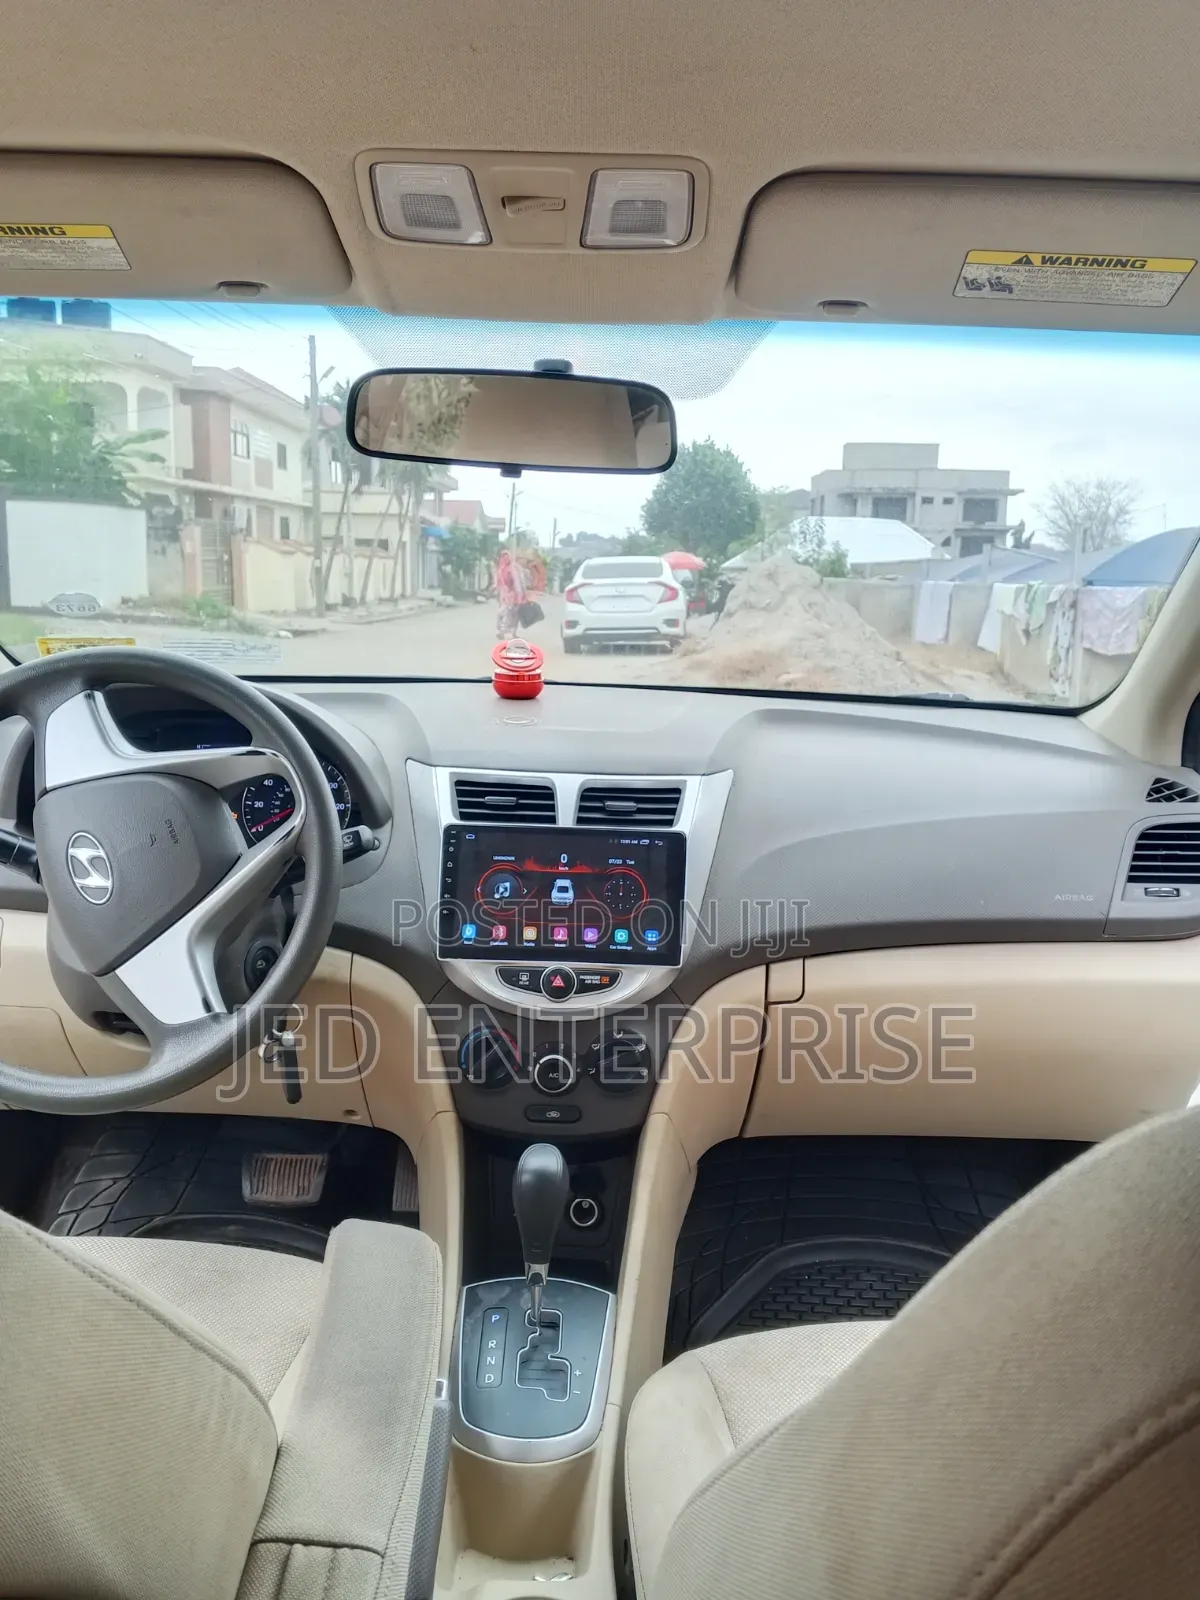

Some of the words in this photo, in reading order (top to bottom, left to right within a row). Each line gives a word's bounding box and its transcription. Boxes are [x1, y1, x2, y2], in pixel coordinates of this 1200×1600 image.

[1040, 255, 1148, 269] WARNING
[164, 818, 180, 845] AIRBAG
[257, 824, 264, 832] 0
[560, 853, 568, 863] 0
[1054, 894, 1095, 902] AIRBAG
[491, 1314, 500, 1323] P
[488, 1340, 497, 1349] R
[486, 1356, 496, 1366] N
[484, 1373, 495, 1384] D
